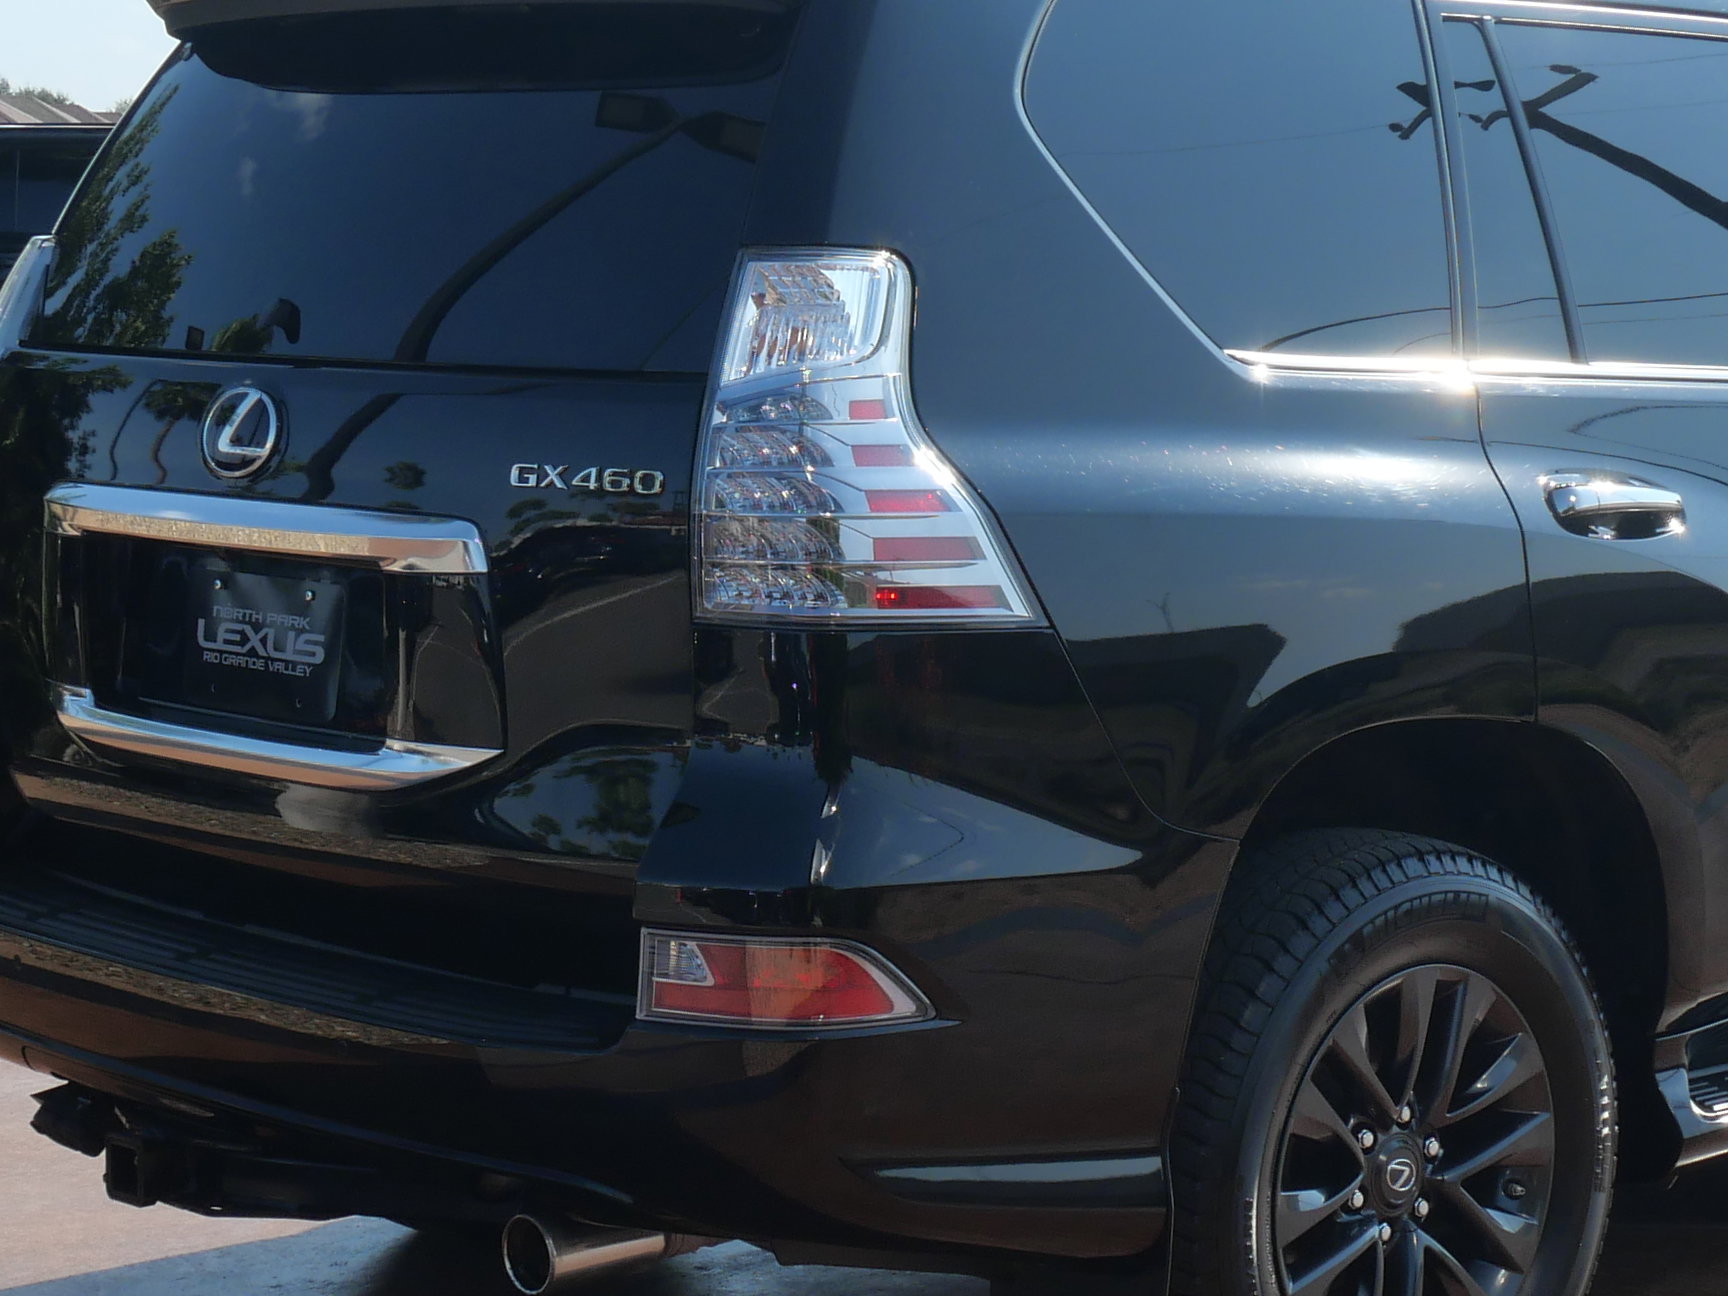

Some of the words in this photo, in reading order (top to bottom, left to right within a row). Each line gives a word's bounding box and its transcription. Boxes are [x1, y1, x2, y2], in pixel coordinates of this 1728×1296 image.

[509, 463, 664, 495] GX460
[213, 605, 262, 623] NORTH
[266, 612, 311, 629] PARK
[197, 618, 325, 665] LEXUS
[203, 651, 220, 663] RIO
[222, 653, 265, 670] GRANDE
[268, 661, 313, 677] VALLEY
